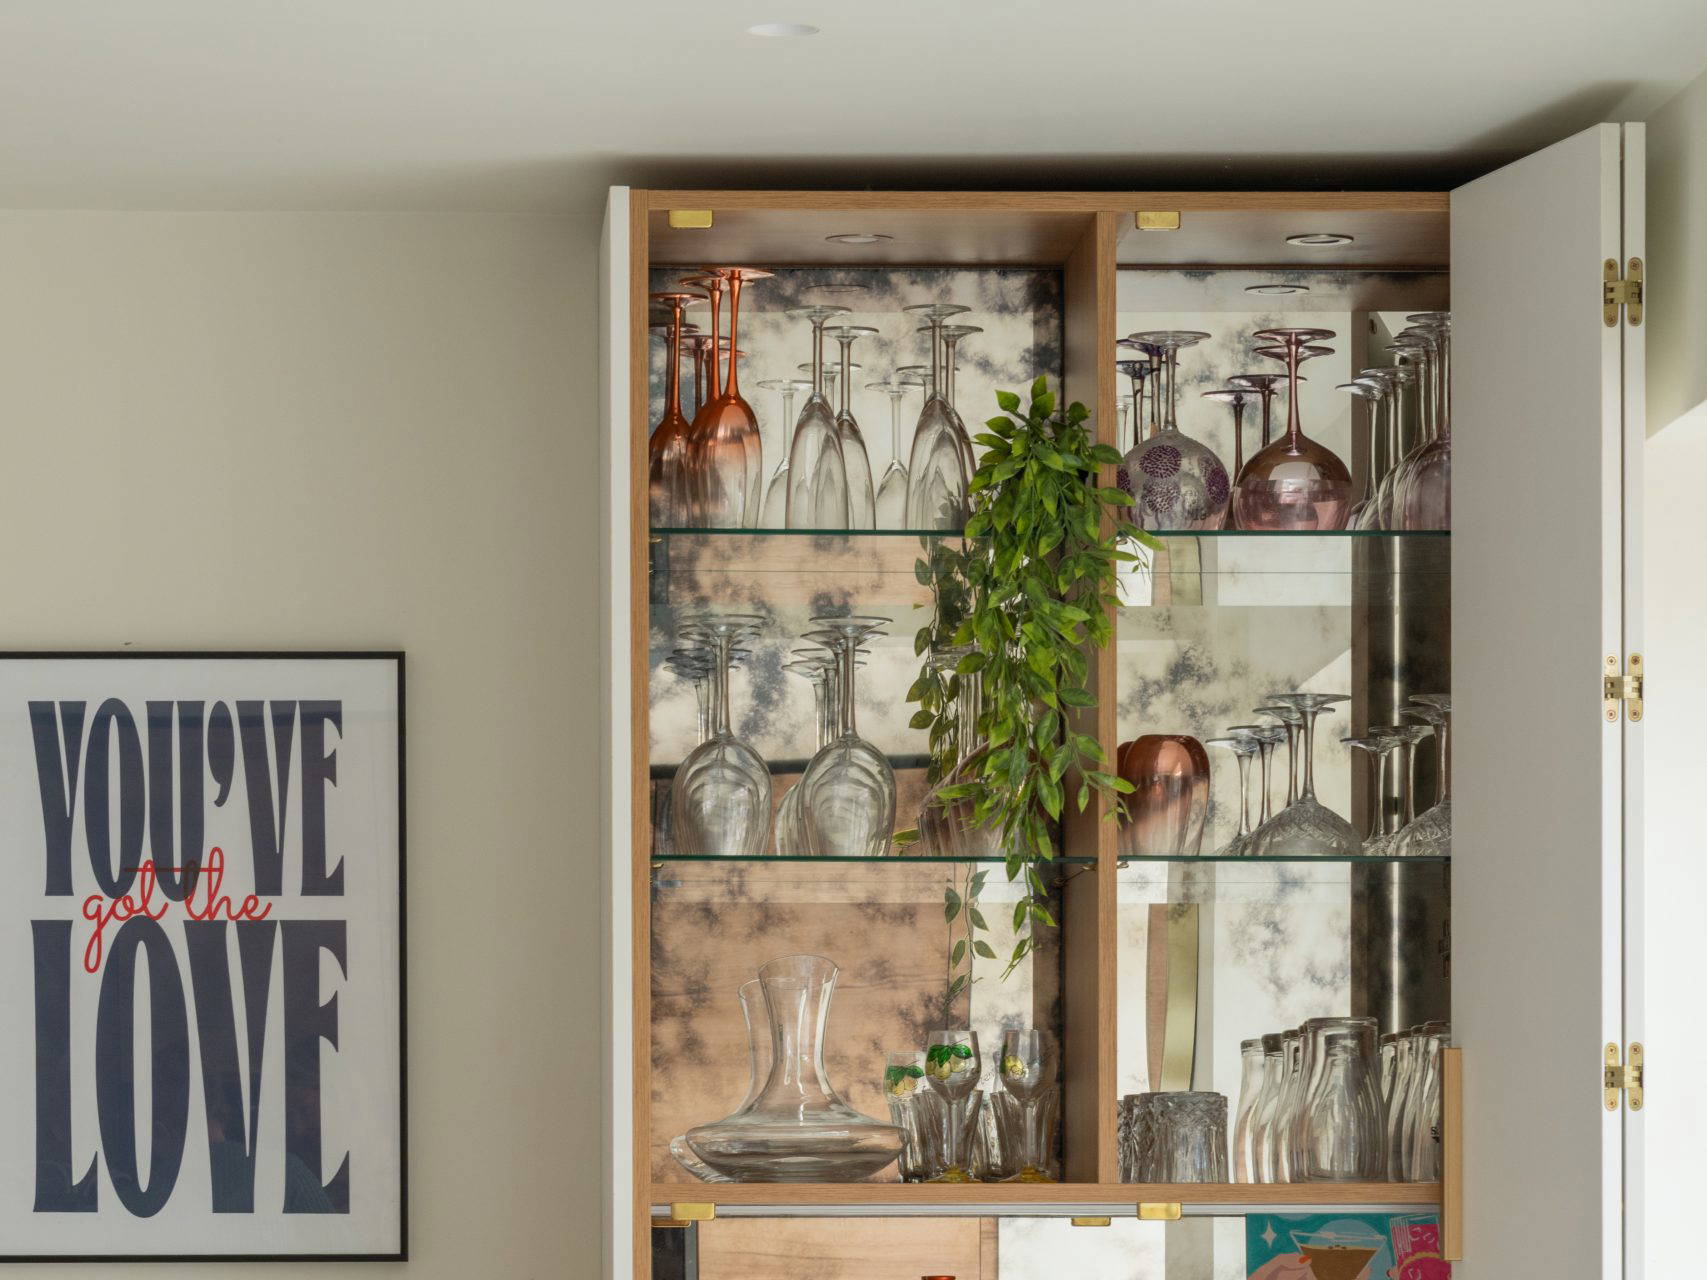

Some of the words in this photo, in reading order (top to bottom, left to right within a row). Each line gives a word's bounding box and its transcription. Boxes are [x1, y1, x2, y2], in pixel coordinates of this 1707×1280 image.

[28, 697, 345, 901] YOU'VE
[83, 858, 169, 973] got
[183, 847, 272, 921] the
[31, 915, 351, 1218] LOVE
